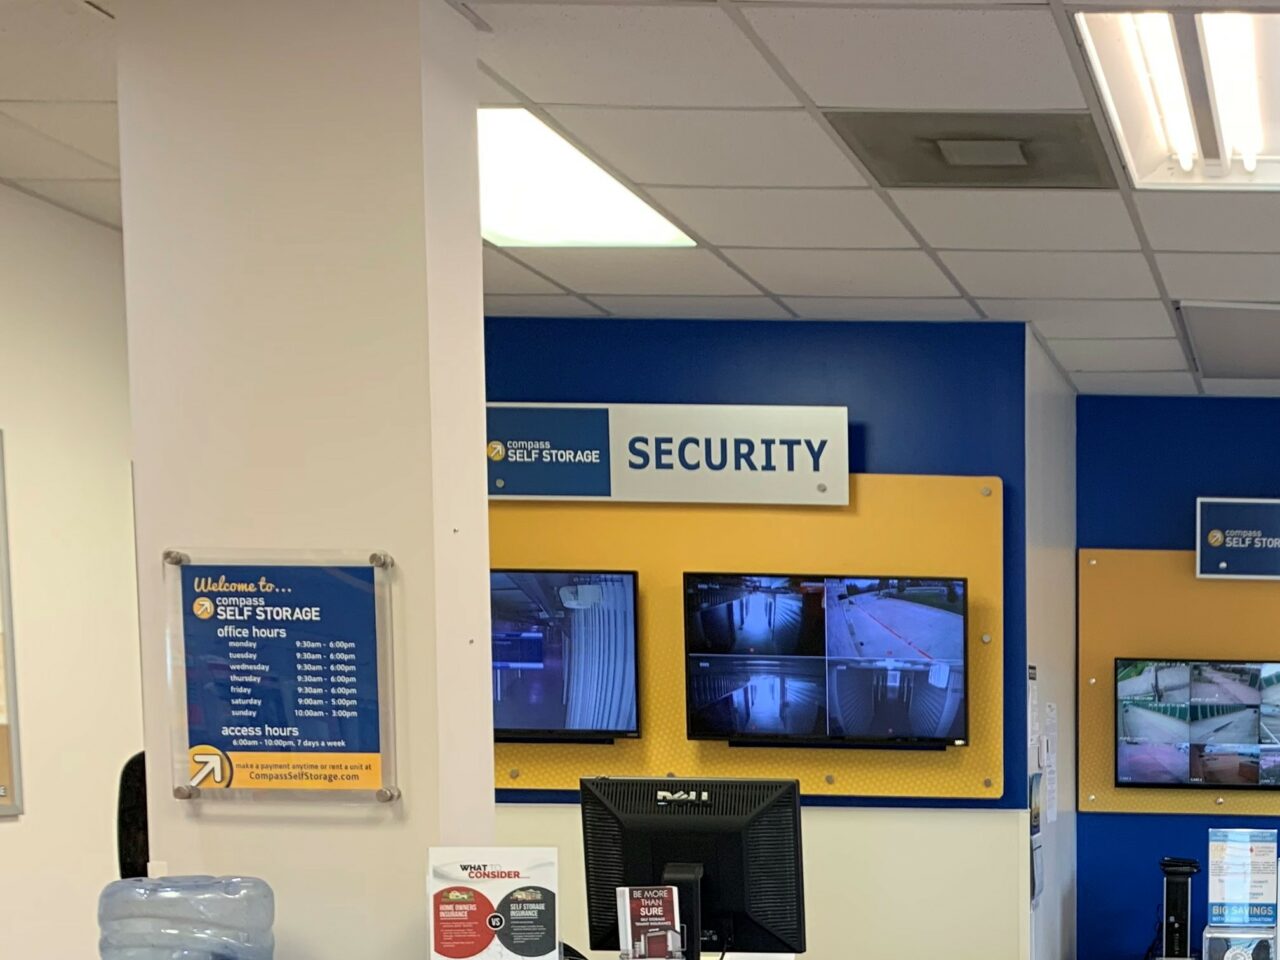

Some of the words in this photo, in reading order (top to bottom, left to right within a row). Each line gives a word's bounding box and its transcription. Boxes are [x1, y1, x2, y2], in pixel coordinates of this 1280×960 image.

[507, 439, 550, 451] compass
[507, 450, 539, 462] SELF
[542, 450, 600, 464] STORAGE
[628, 436, 828, 472] SECURITY
[1225, 529, 1262, 539] compass
[1225, 536, 1252, 547] SELF
[194, 575, 256, 592] Welcome
[216, 597, 265, 608] compass
[217, 607, 252, 620] SELF
[256, 607, 320, 620] STORAGE
[217, 625, 249, 637] office
[252, 626, 287, 637] hours
[229, 641, 257, 649] monday
[229, 652, 257, 660] tuesday
[230, 664, 269, 672] wednesday
[230, 675, 261, 684] thursday
[231, 686, 251, 695] friday
[231, 698, 261, 706] saturday
[232, 709, 257, 717] sunday
[221, 726, 262, 736] access
[265, 724, 299, 736] hours
[303, 740, 320, 748] days
[327, 740, 346, 748] week
[261, 764, 291, 772] payment
[292, 763, 319, 771] anytime
[249, 771, 360, 783] CompassSelfStorage.com
[633, 890, 642, 898] BE
[644, 890, 668, 898] MORE
[640, 907, 664, 916] SURE
[1213, 906, 1227, 915] BIG
[1231, 906, 1273, 915] SAVINGS
[491, 918, 501, 926] VS
